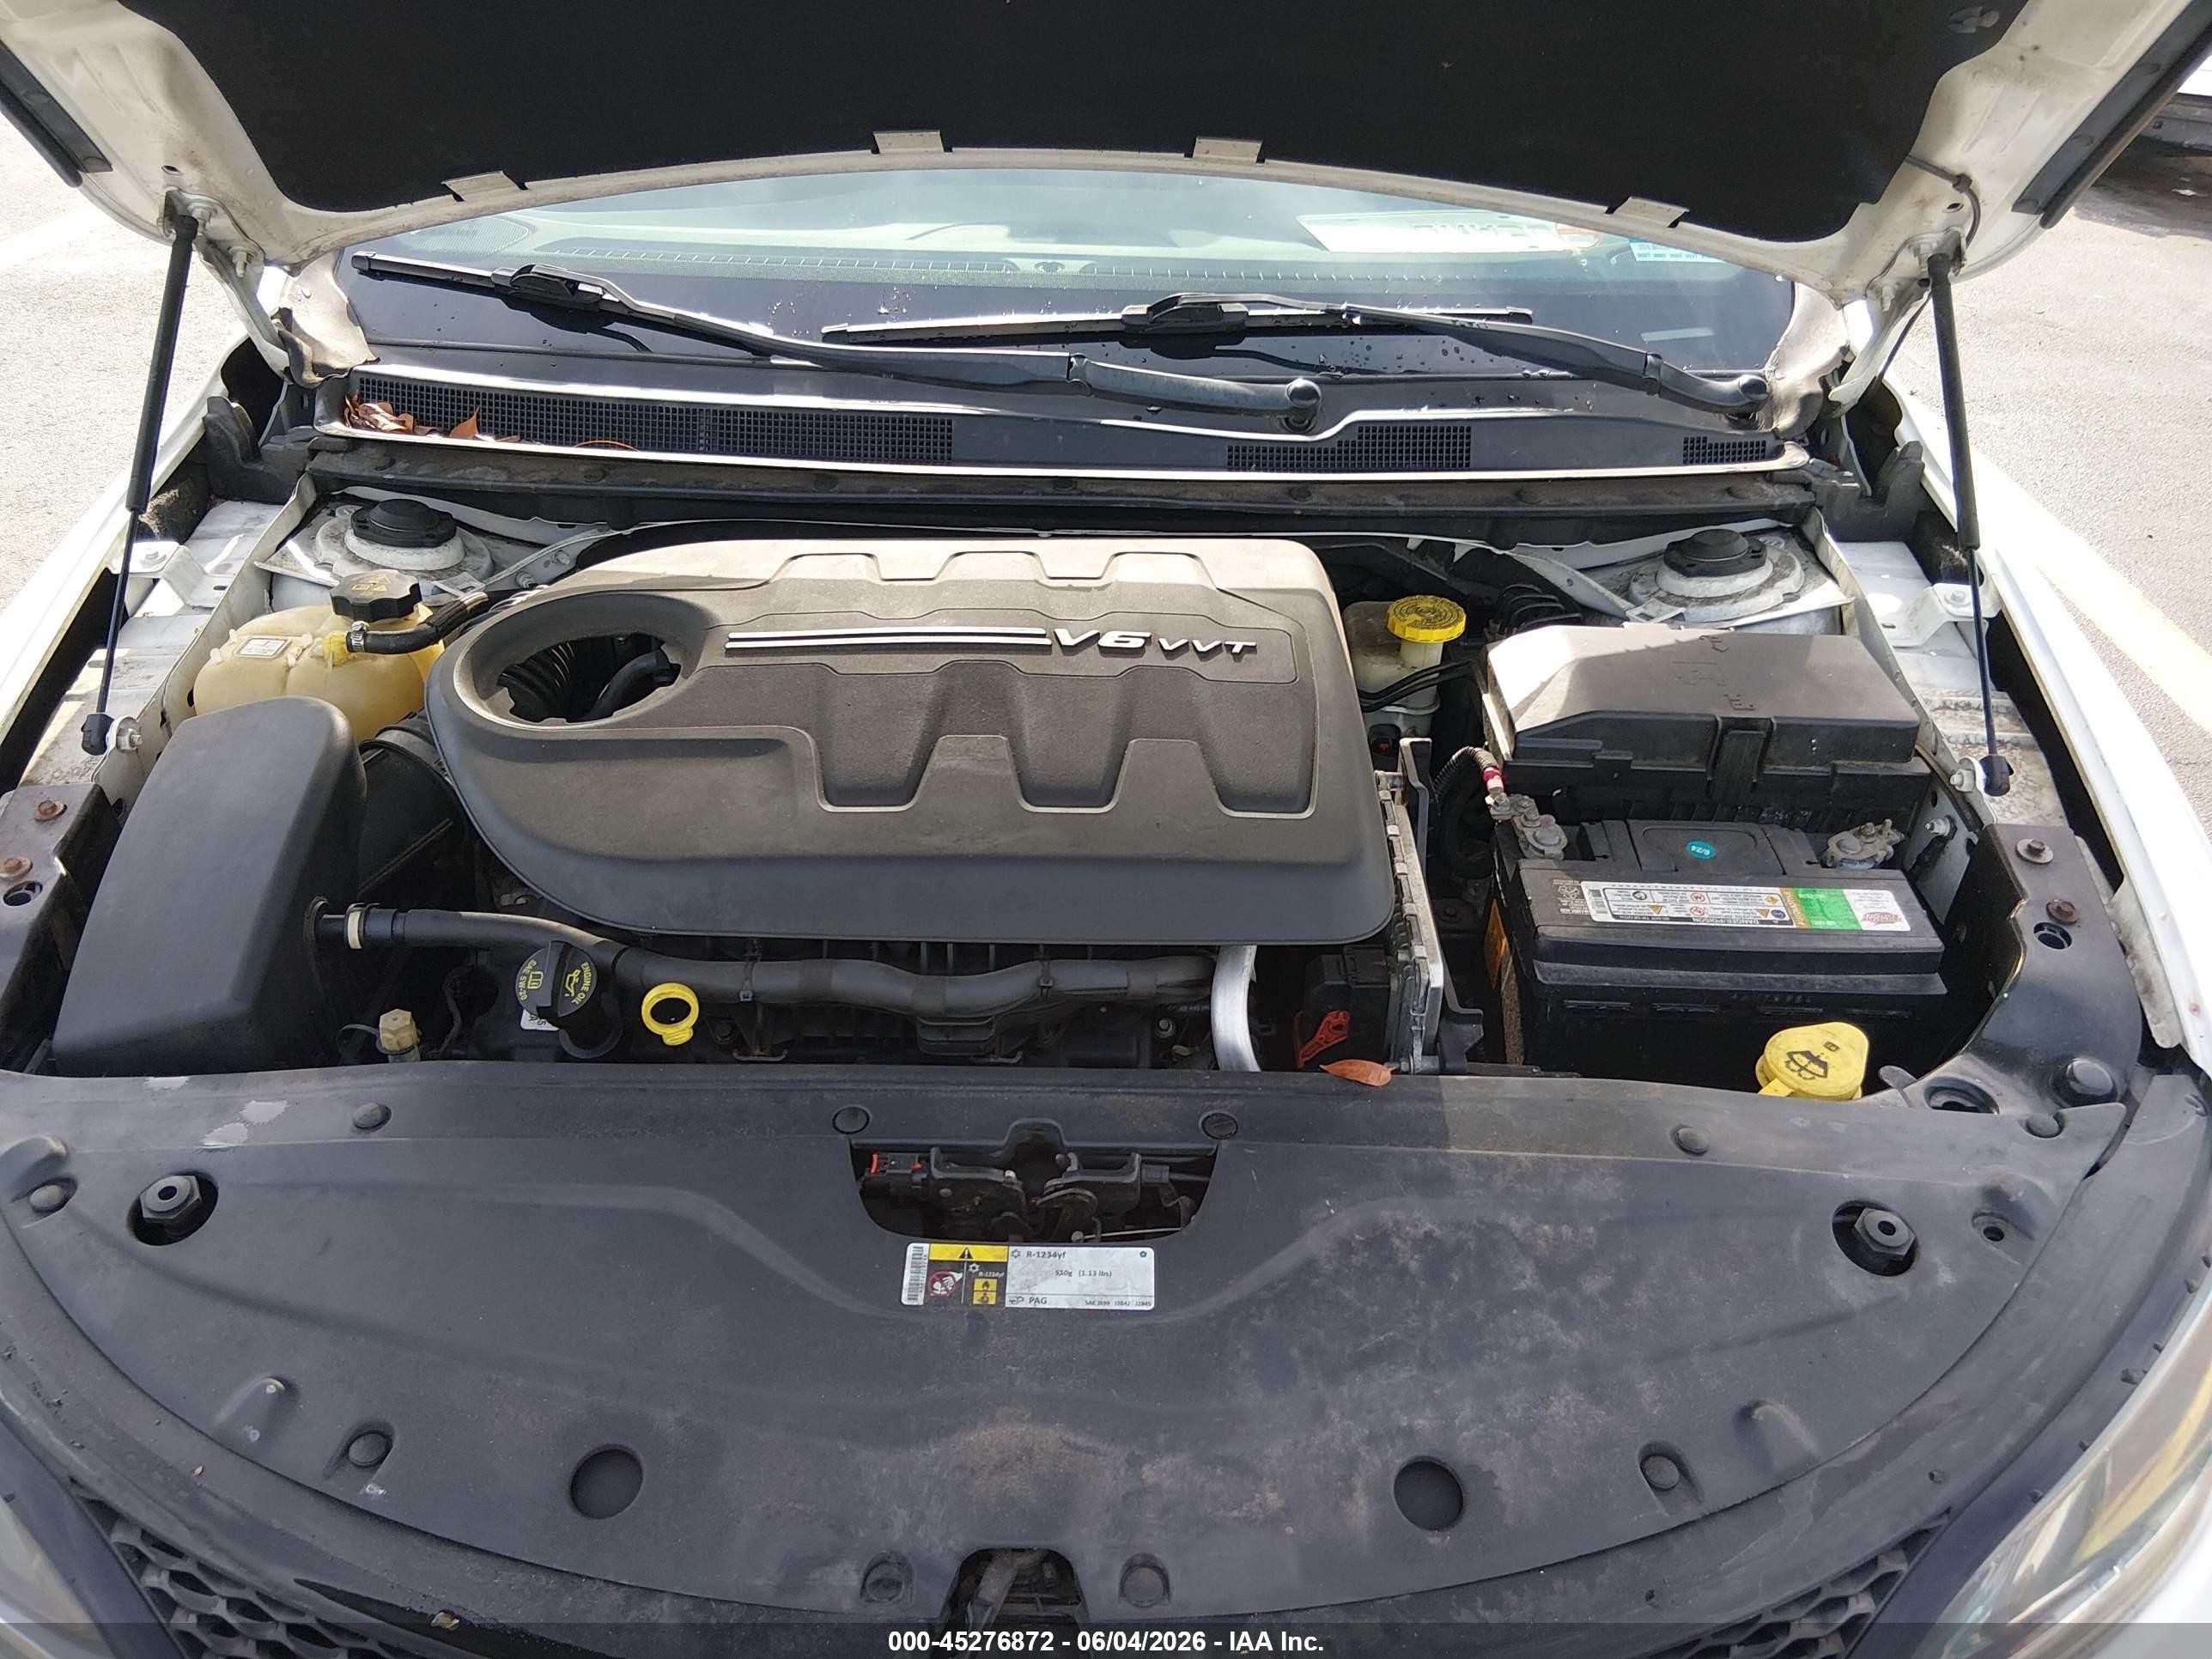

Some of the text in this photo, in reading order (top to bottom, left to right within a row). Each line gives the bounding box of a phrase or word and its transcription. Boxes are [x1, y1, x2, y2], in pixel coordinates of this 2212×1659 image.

[1053, 628, 1258, 657] V6 VVT
[519, 959, 537, 1001] SAE 5W-20
[571, 962, 592, 1006] ENGINE OIL
[1025, 1250, 1066, 1261] R-1234yf
[1079, 1268, 1097, 1278] (1.13
[1097, 1269, 1113, 1279] lbs)
[1029, 1297, 1048, 1306] PAG
